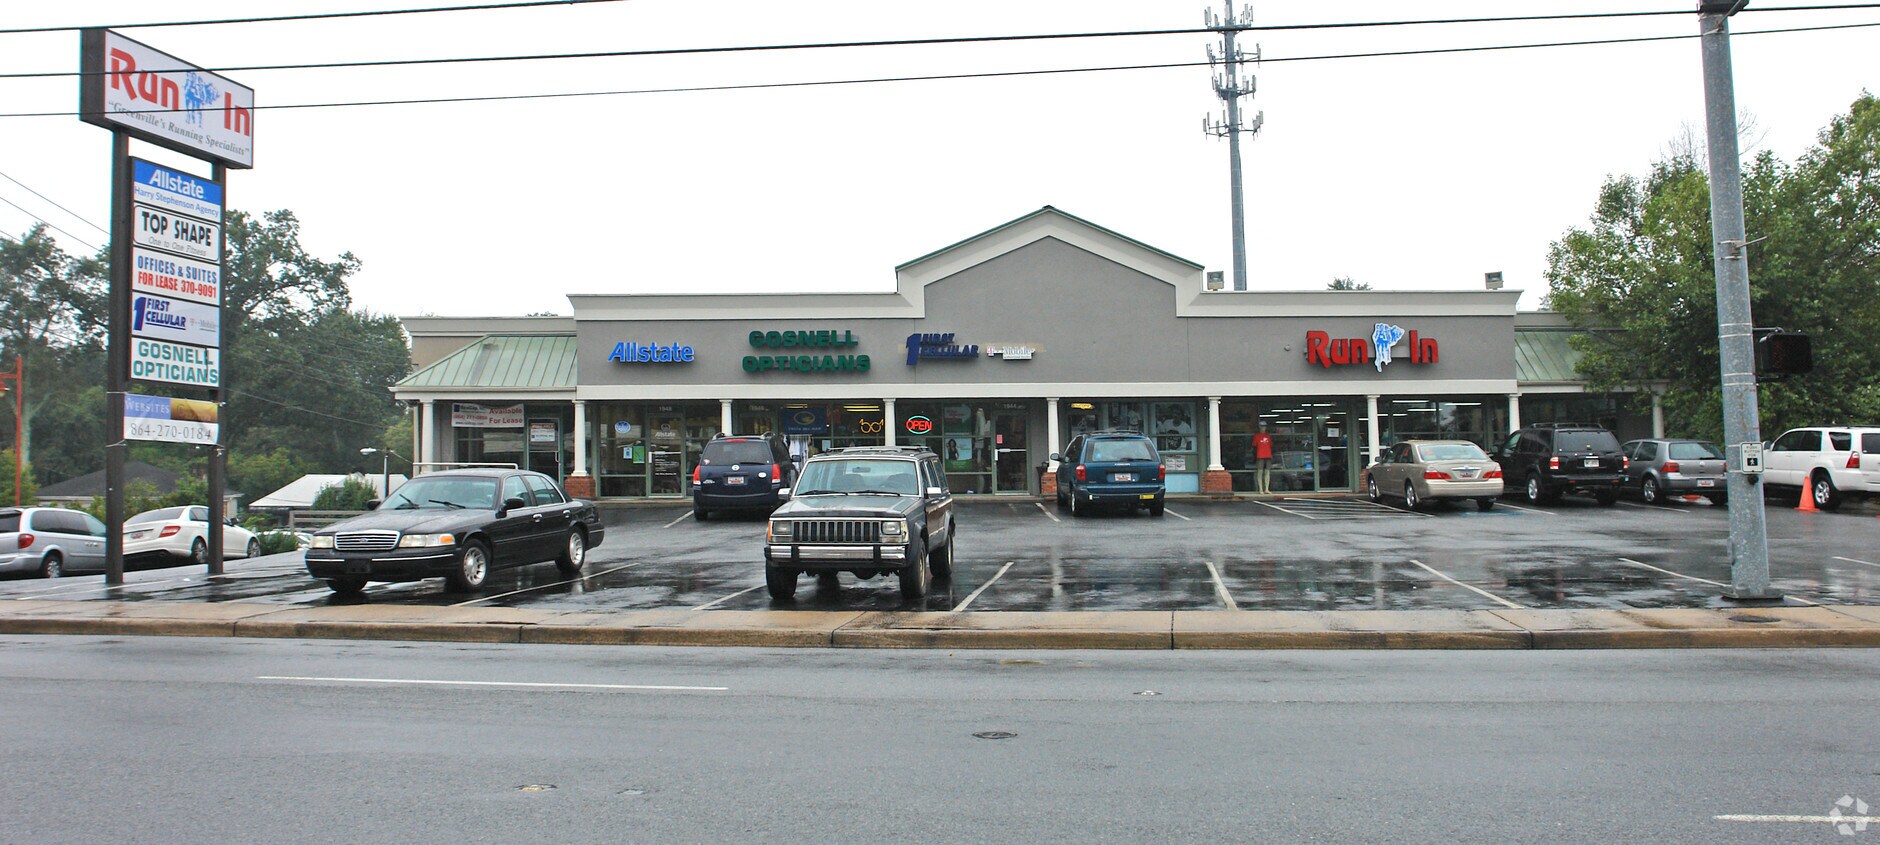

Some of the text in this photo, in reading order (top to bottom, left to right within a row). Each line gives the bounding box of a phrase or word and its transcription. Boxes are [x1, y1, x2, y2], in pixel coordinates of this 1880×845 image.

[110, 47, 250, 137] Run In
[168, 121, 204, 144] Running
[149, 169, 204, 199] Allstate
[134, 187, 219, 218] Harry Stephenson Agency
[141, 211, 211, 247] TOP SHAPE
[148, 236, 162, 247] One
[137, 255, 217, 284] OFFICES & SUITES
[137, 271, 217, 298] FOR LEASE 370-9091
[145, 298, 170, 312] FIRST
[144, 311, 186, 328] CELLULAR
[749, 330, 858, 348] GOSNELL
[1306, 329, 1439, 368] Run In
[138, 342, 214, 365] GOSNELL
[608, 342, 695, 362] Allstate
[919, 345, 979, 357] CELLULAR
[133, 360, 218, 384] OPTICIANS
[742, 355, 871, 373] OPTICIANS
[125, 400, 170, 414] WEBSITES
[489, 407, 523, 415] Available
[130, 423, 211, 440] 864-270-0184
[905, 420, 932, 431] OPEN
